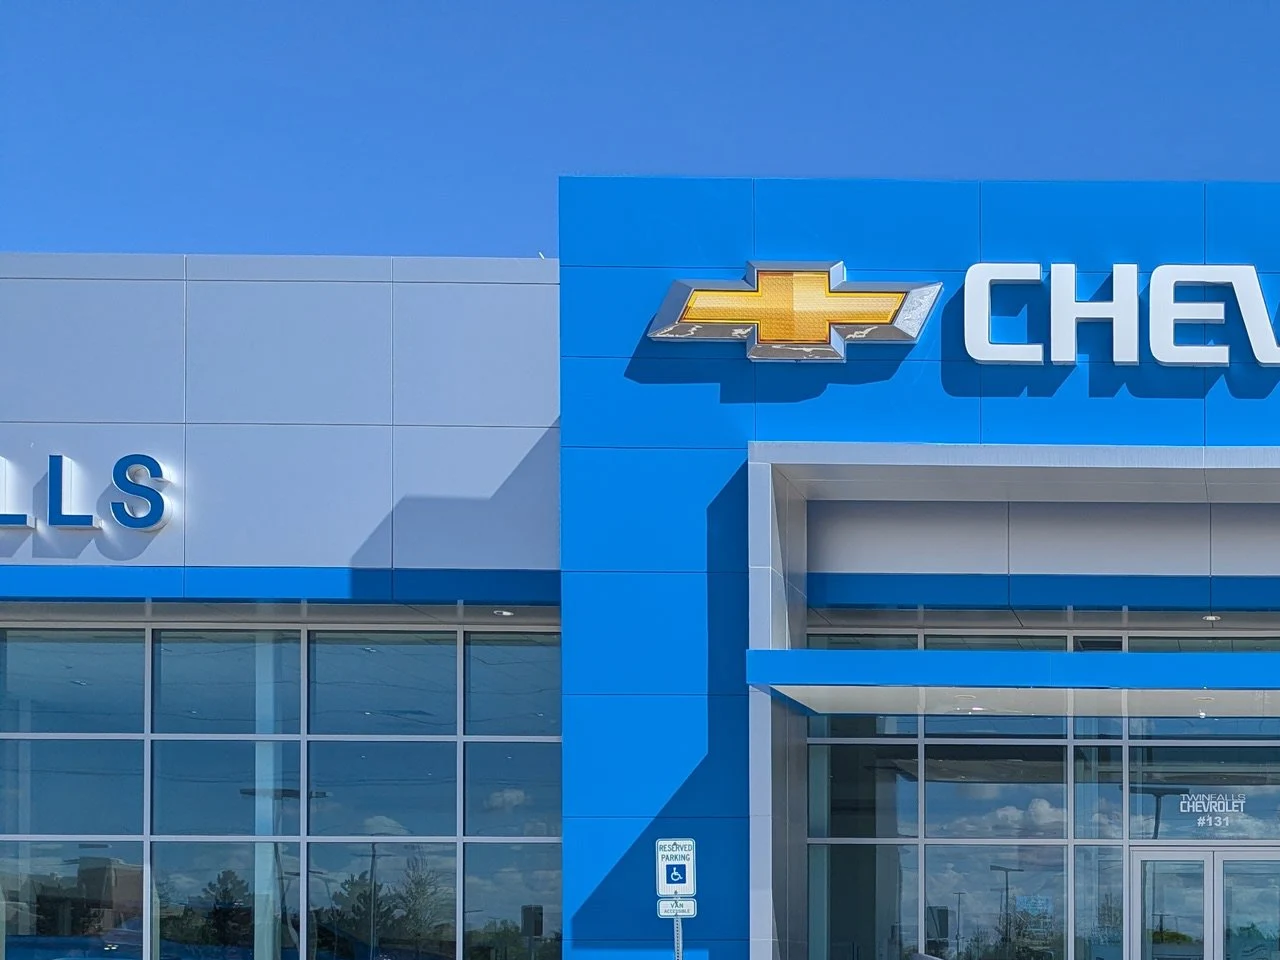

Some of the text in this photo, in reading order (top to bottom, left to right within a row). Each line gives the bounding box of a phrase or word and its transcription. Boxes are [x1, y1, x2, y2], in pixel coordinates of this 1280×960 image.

[1180, 801, 1246, 812] CHEVROLET
[1197, 816, 1230, 827] #131
[659, 844, 693, 852] RESERVED
